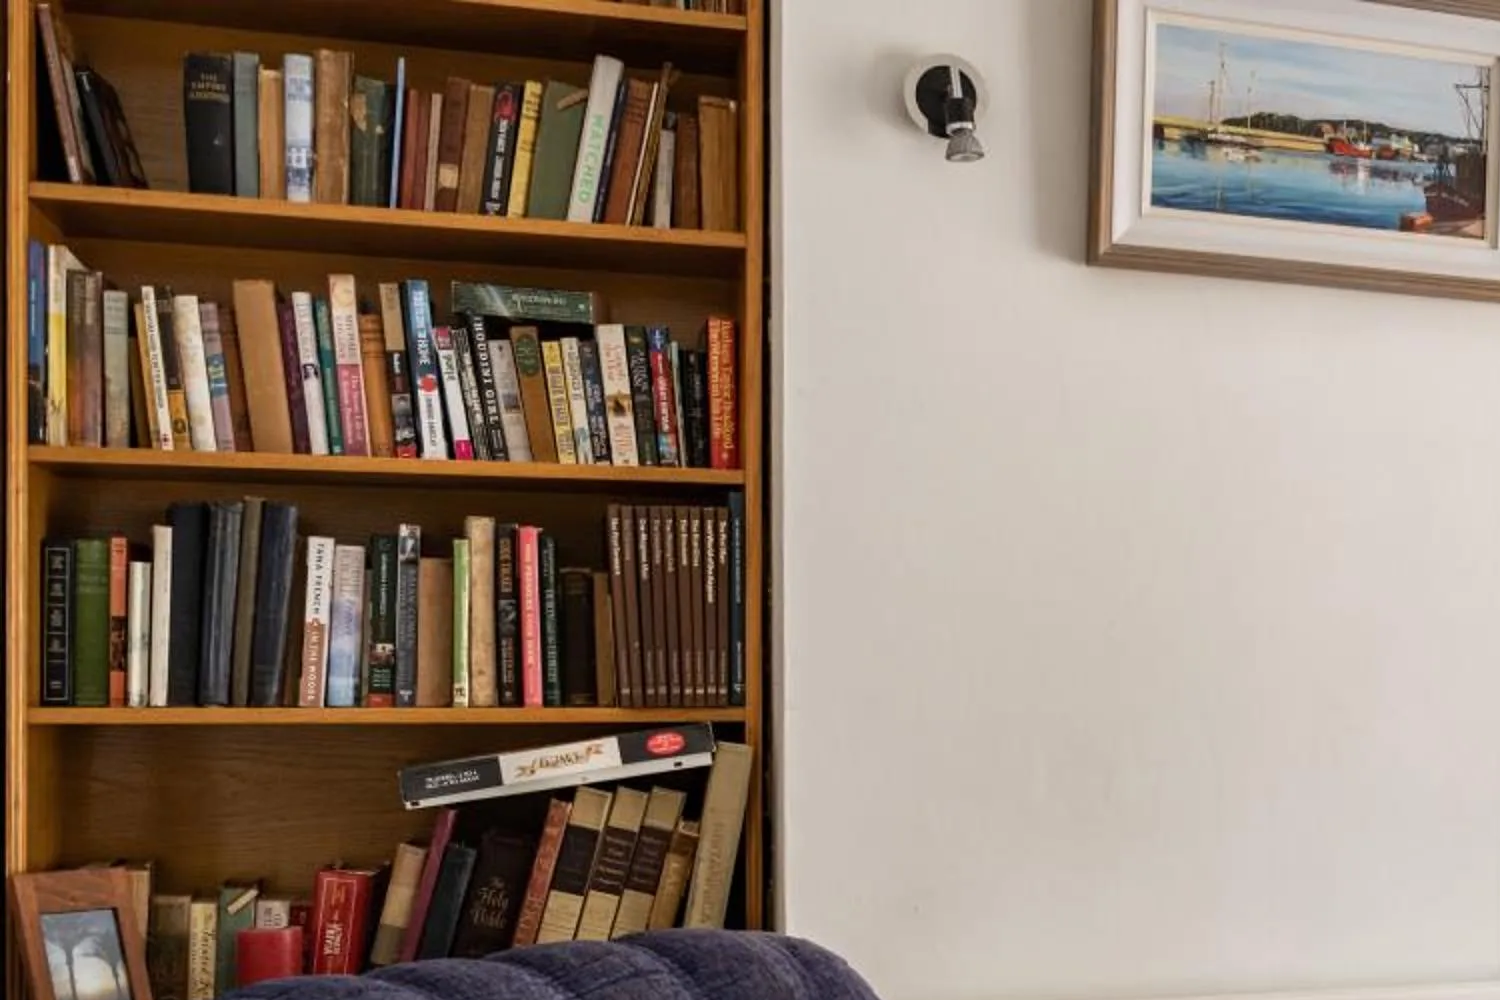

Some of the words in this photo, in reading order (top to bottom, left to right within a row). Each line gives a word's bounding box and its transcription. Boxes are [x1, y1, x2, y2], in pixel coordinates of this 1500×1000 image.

[472, 322, 494, 384] HOUDINI
[485, 388, 500, 425] GIRL
[312, 575, 324, 615] FRENCH
[306, 664, 317, 703] WOODS
[479, 887, 510, 910] Holy
[470, 908, 507, 930] Bible
